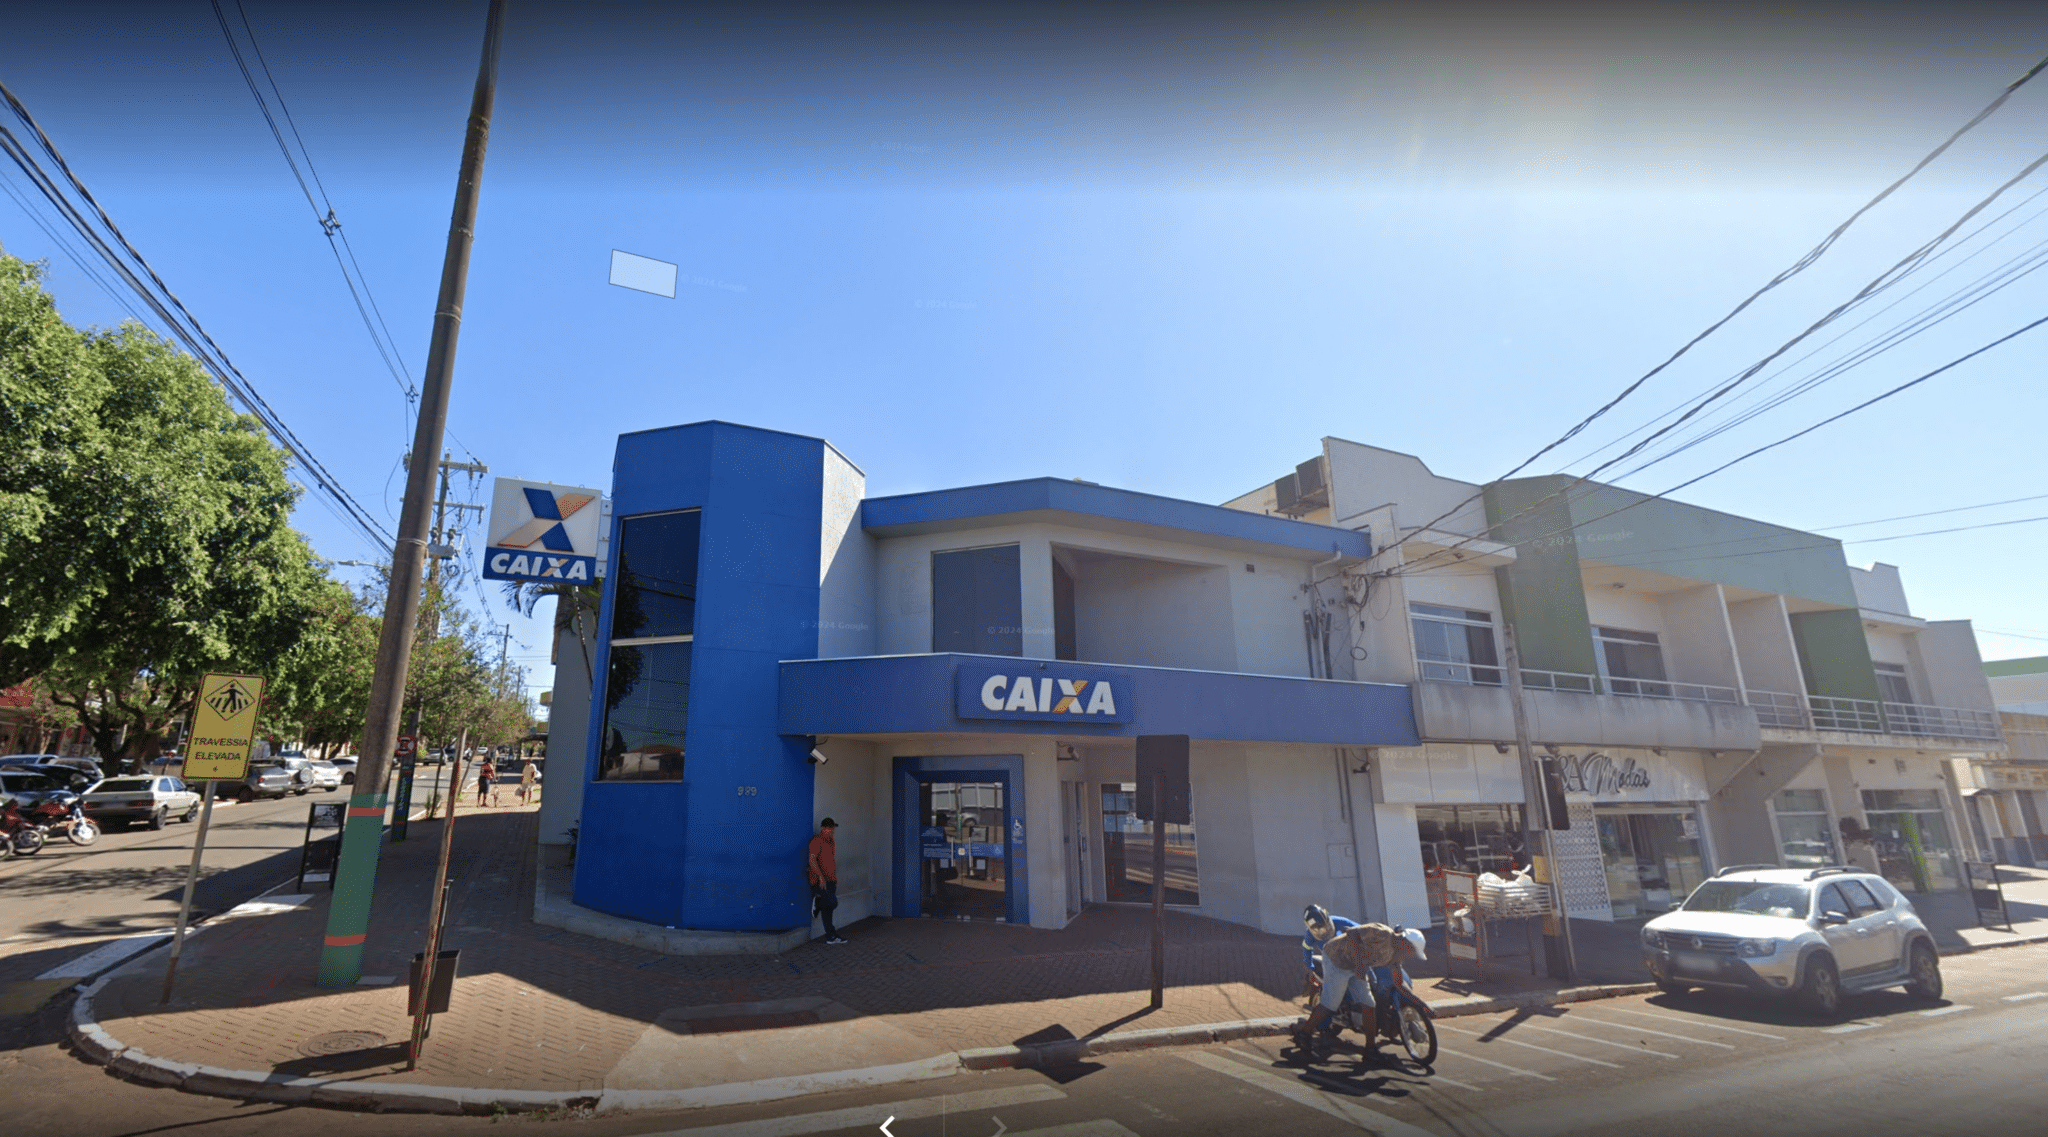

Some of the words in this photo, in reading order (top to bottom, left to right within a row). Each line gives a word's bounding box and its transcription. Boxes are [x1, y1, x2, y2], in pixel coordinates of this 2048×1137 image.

[489, 552, 587, 581] CAIXA
[980, 674, 1118, 716] CAIXA
[193, 737, 248, 747] TRAVESSIA
[194, 751, 242, 760] ELEVADA
[1580, 751, 1651, 796] Modas
